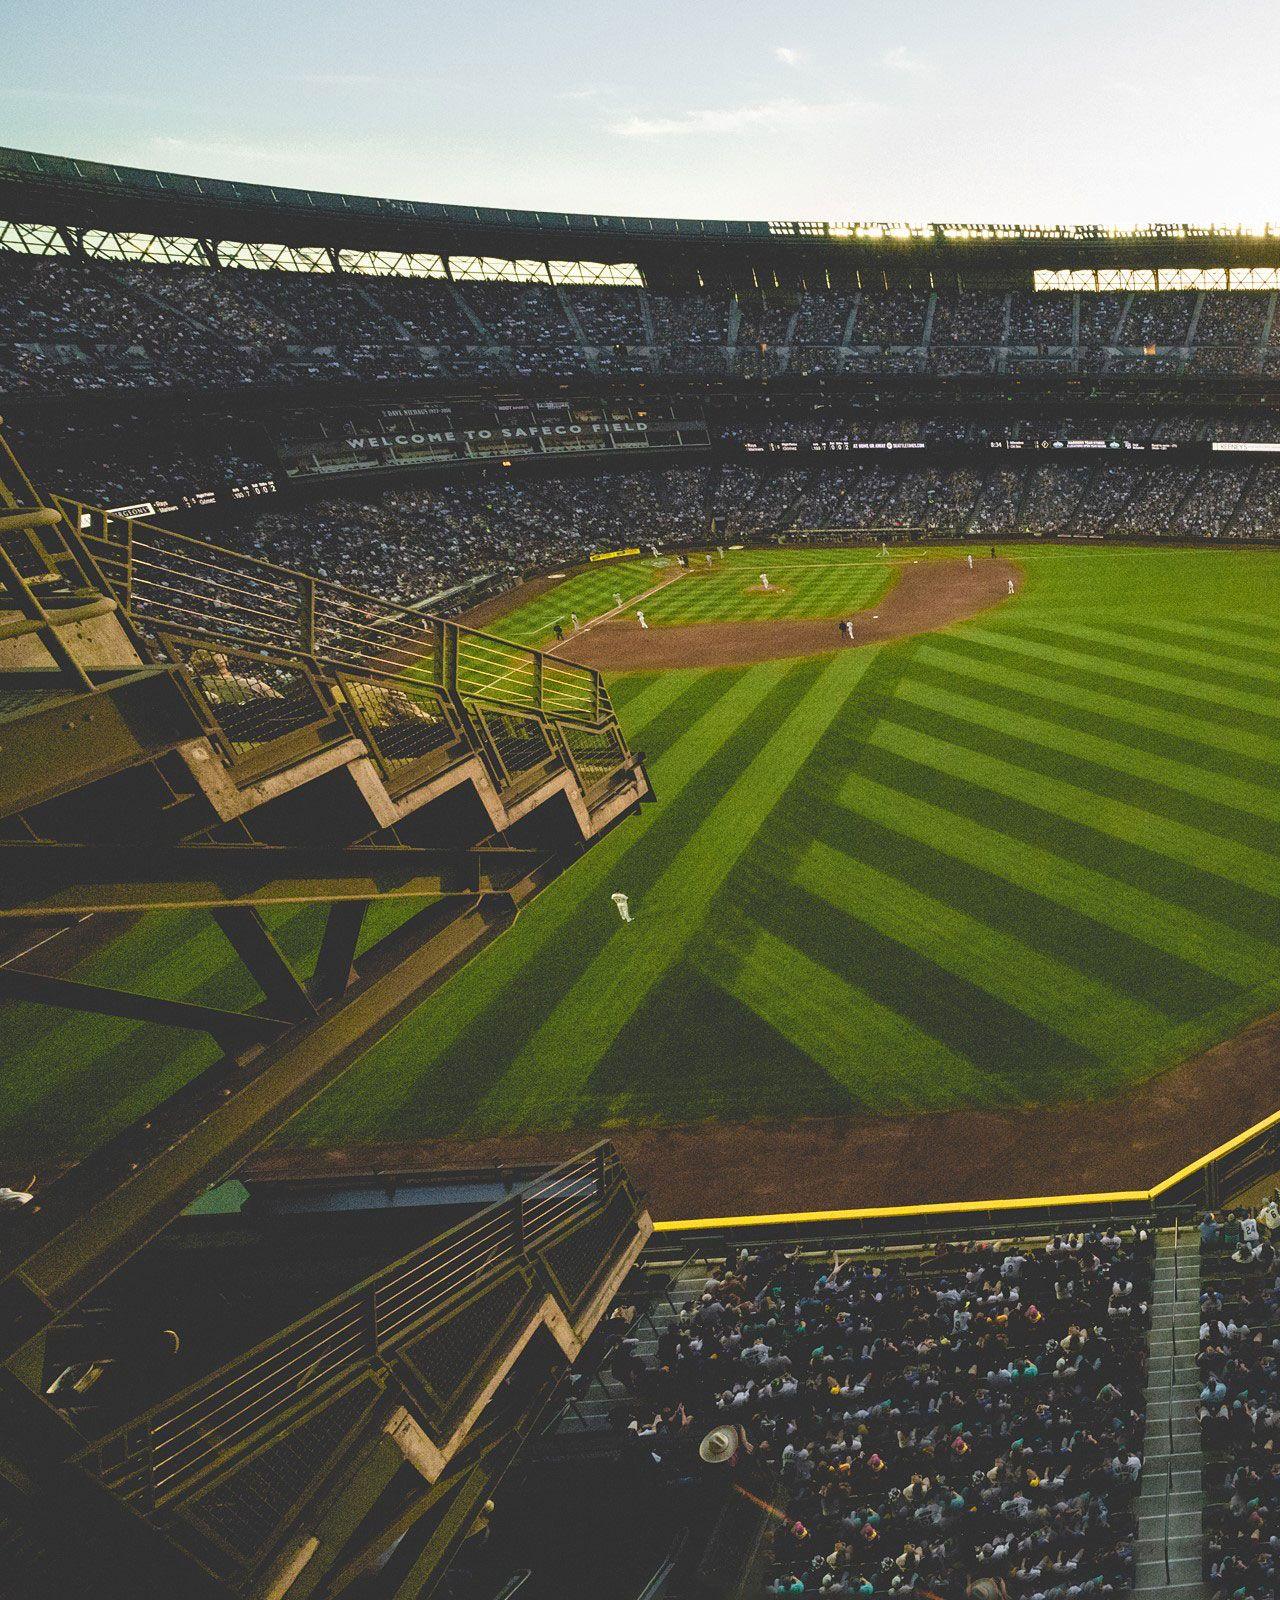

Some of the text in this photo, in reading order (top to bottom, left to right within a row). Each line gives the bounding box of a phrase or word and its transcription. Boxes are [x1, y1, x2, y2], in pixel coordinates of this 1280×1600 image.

[345, 422, 648, 449] WELCOME TO SAFECO FIELD
[1245, 1225, 1256, 1235] 24
